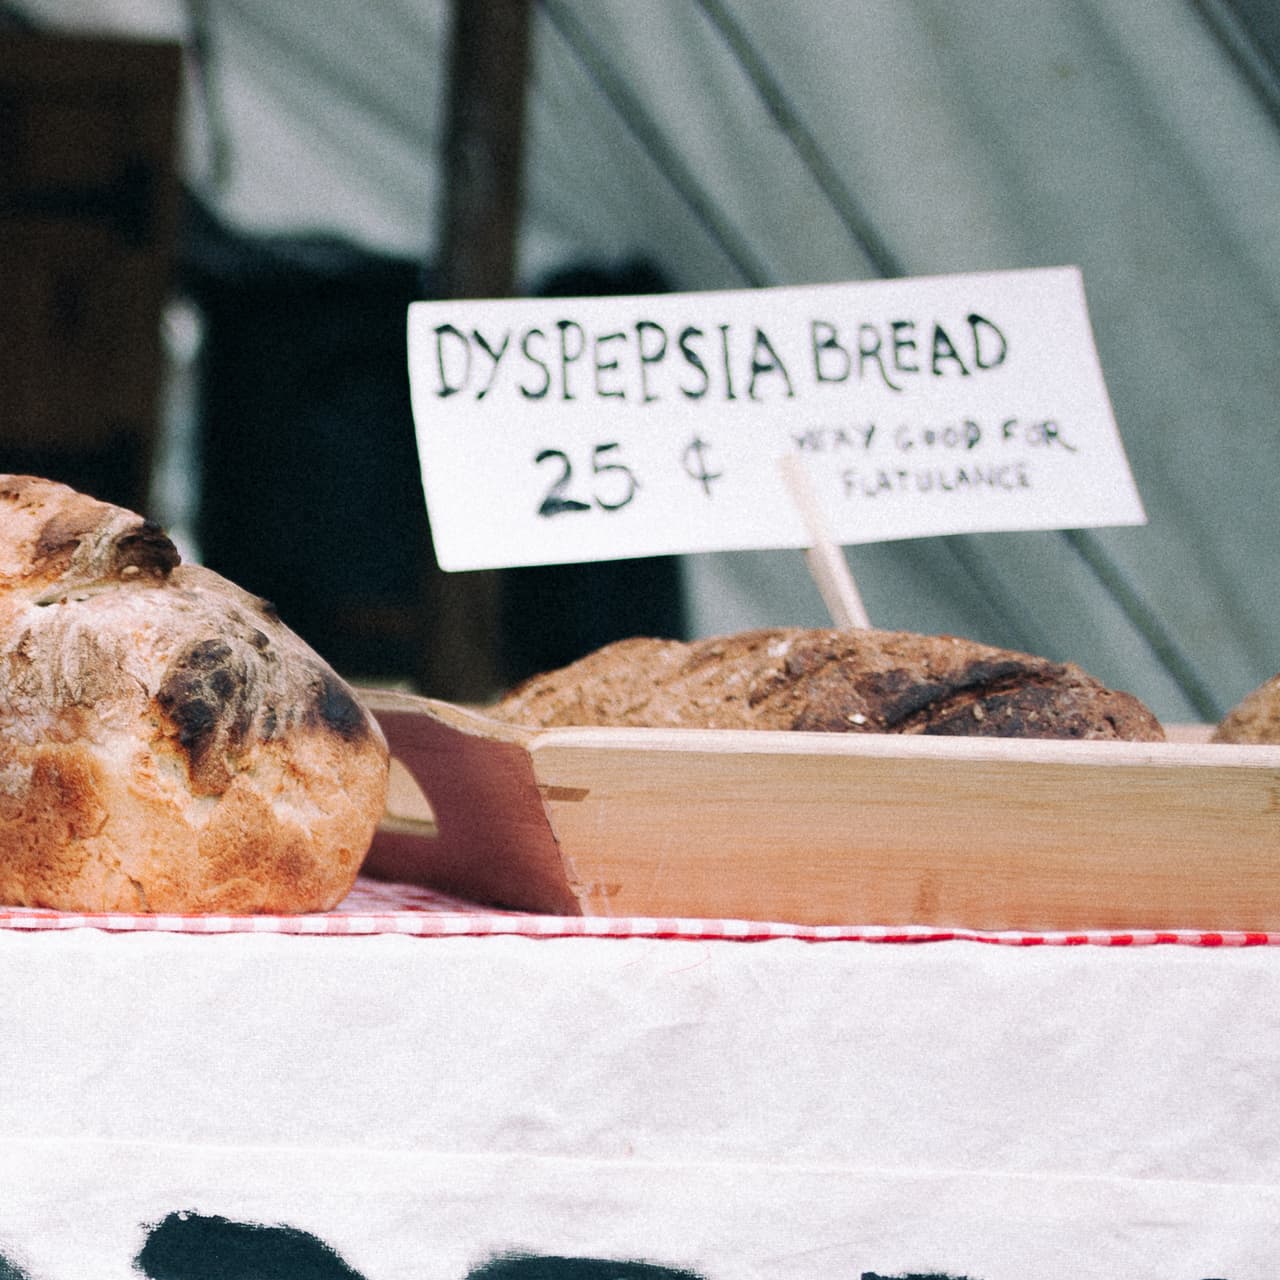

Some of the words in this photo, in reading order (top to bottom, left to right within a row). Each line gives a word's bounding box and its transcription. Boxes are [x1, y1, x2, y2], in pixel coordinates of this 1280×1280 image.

[432, 318, 795, 404] DYSPEPSIA
[810, 312, 1009, 393] BREAD
[895, 419, 982, 451] GOOD
[1001, 419, 1077, 453] FOR
[534, 441, 639, 518] 25
